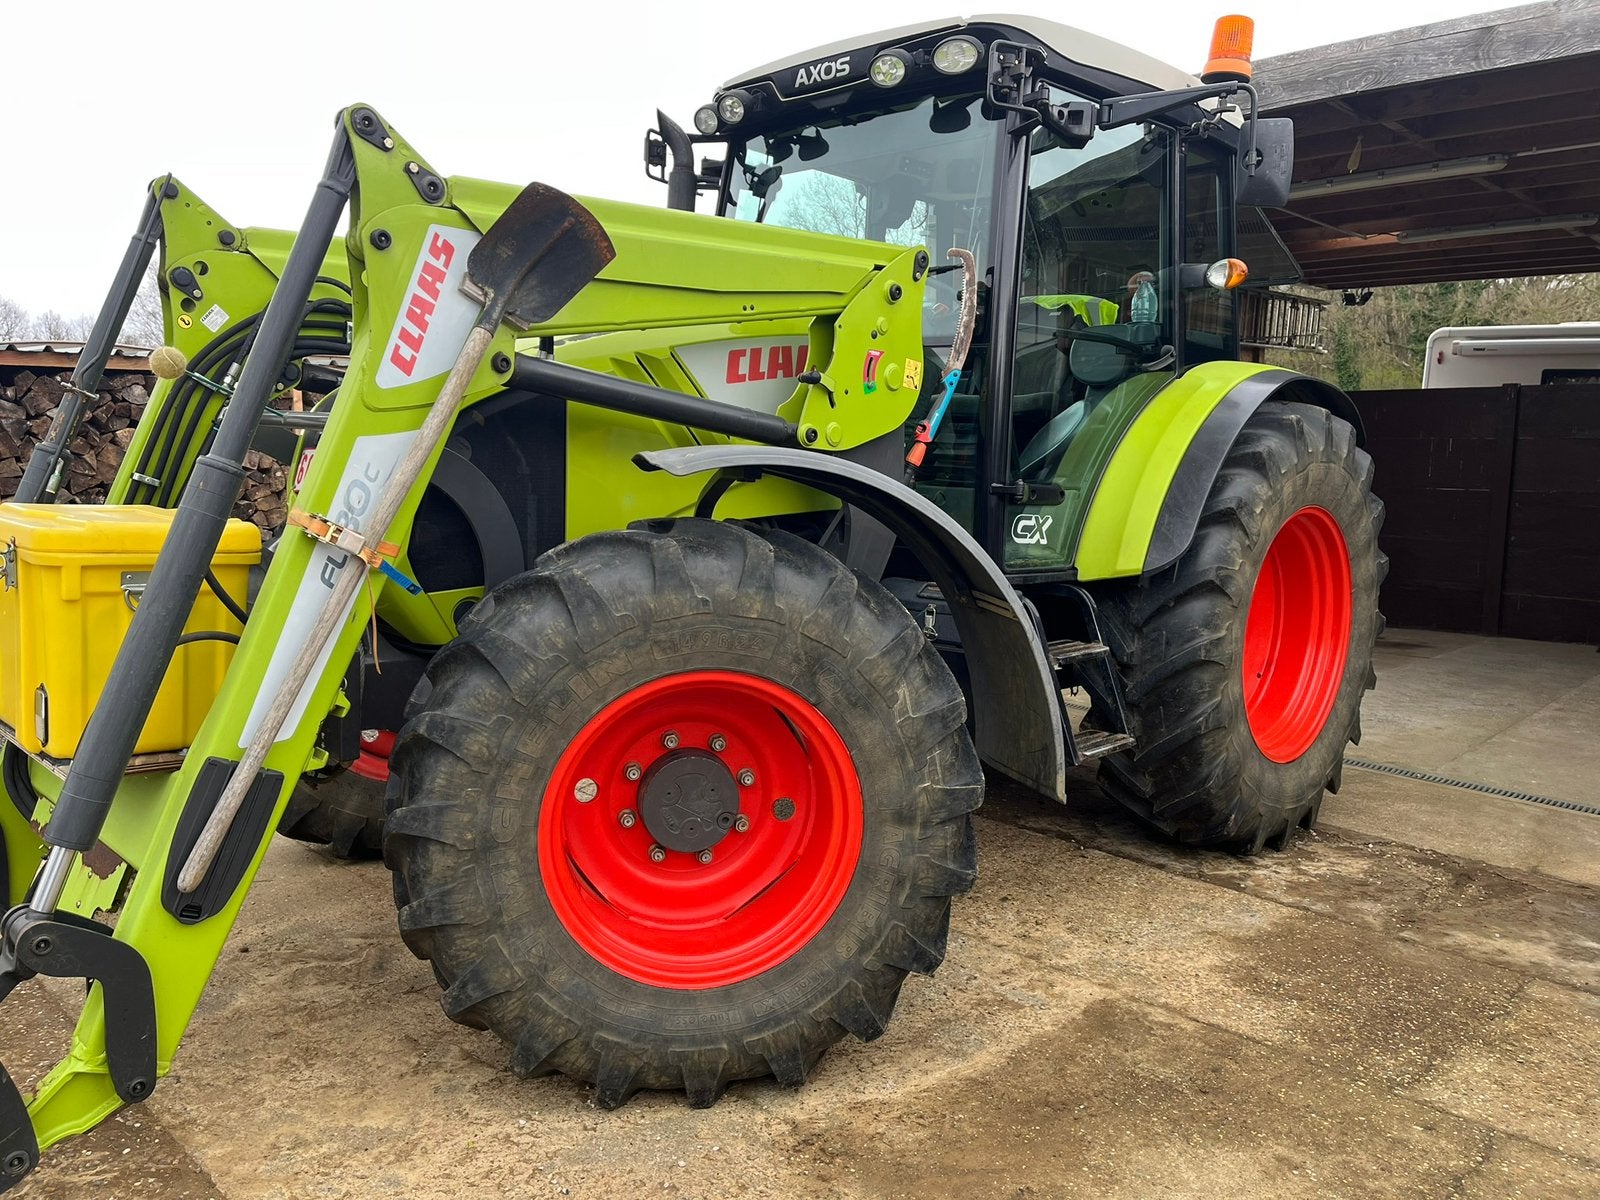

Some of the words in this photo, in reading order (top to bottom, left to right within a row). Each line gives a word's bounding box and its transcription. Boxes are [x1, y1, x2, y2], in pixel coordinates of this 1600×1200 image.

[794, 56, 851, 88] AXOS
[390, 231, 455, 377] CLAAS
[1011, 513, 1053, 545] CX
[490, 646, 633, 923] MICHELIN
[835, 823, 905, 960] AGRIBIB
